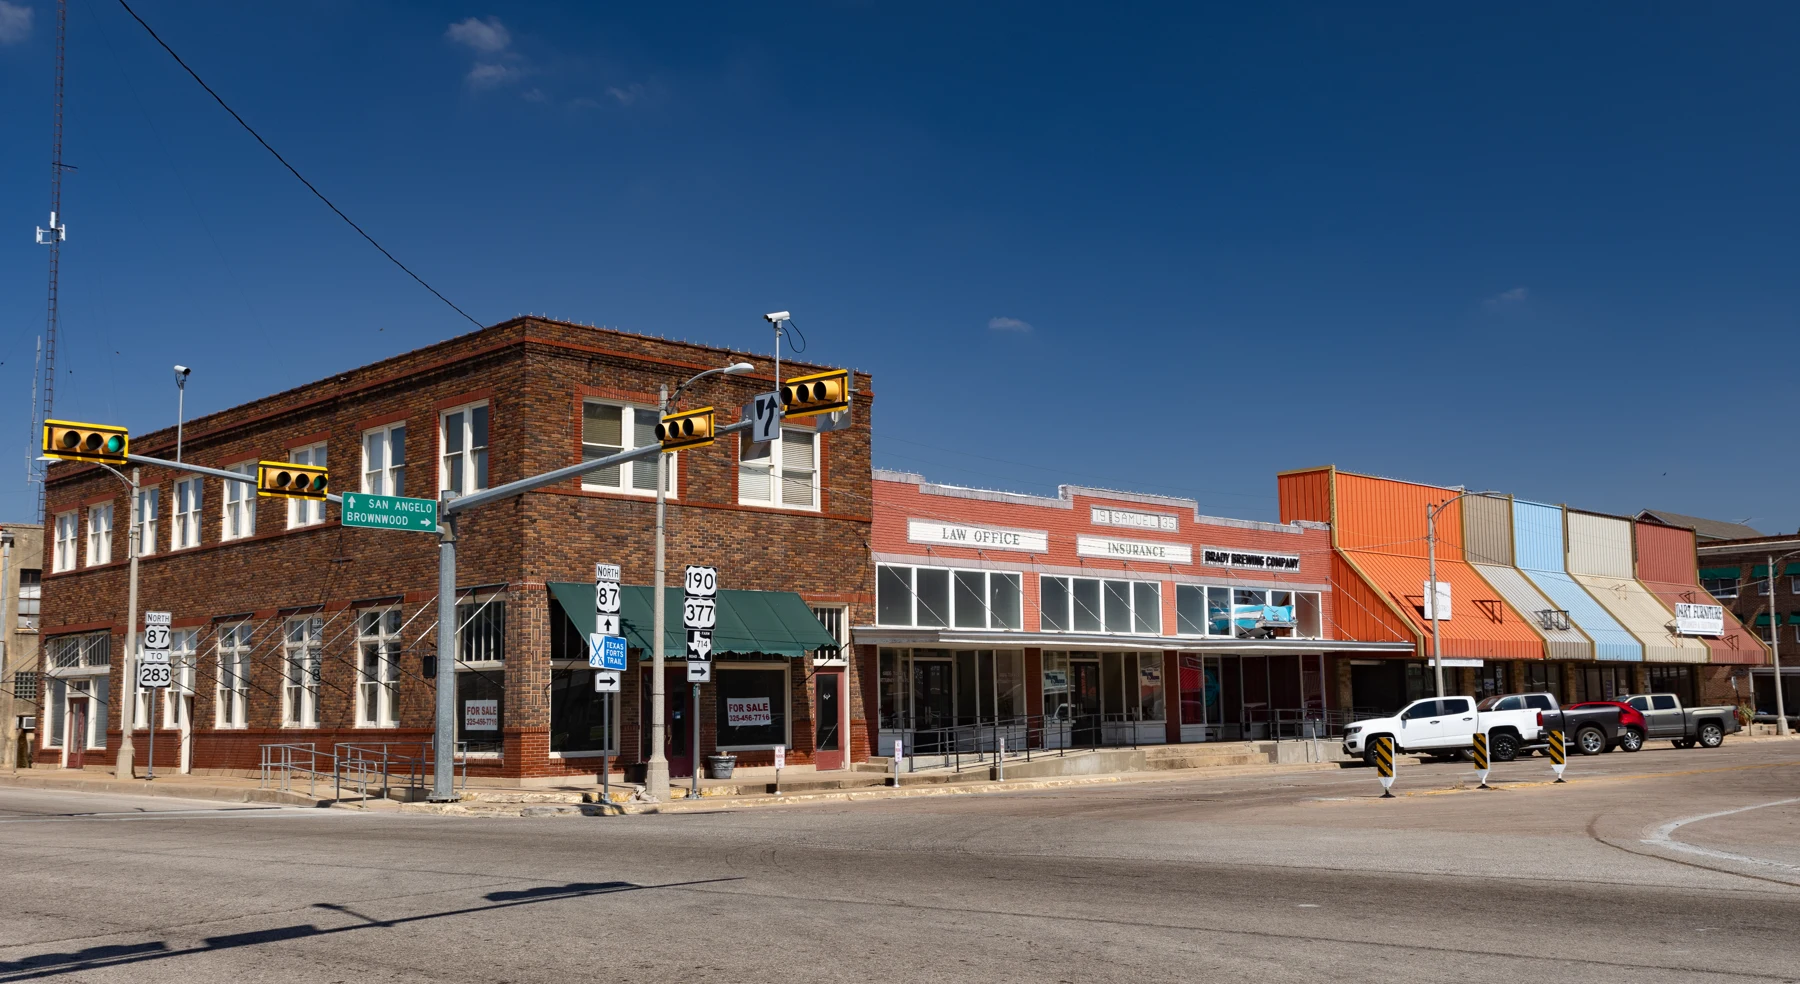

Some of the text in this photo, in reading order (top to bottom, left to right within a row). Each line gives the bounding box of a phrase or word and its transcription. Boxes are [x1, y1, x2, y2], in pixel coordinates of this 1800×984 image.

[368, 498, 432, 513] SAN ANGELO
[347, 511, 408, 526] BROWNWOOD
[1114, 513, 1156, 527] SAMUEL
[1162, 517, 1174, 529] 35
[942, 528, 1020, 545] LAW OFFICE
[1107, 542, 1165, 557] INSURANCE
[1205, 551, 1230, 564] BRADY
[1266, 556, 1299, 569] COMPANY
[597, 566, 619, 578] NORTH
[688, 572, 714, 590] 190
[598, 588, 618, 605] 87
[147, 613, 170, 622] NORTH
[686, 604, 714, 622] 377
[147, 630, 168, 643] 87
[606, 641, 624, 650] TEXAS
[696, 640, 708, 648] 714
[606, 649, 624, 658] FORTS
[607, 656, 623, 666] TRAIL
[142, 668, 170, 682] 283
[466, 706, 497, 716] FOR SALE
[728, 703, 769, 712] FOR SALE
